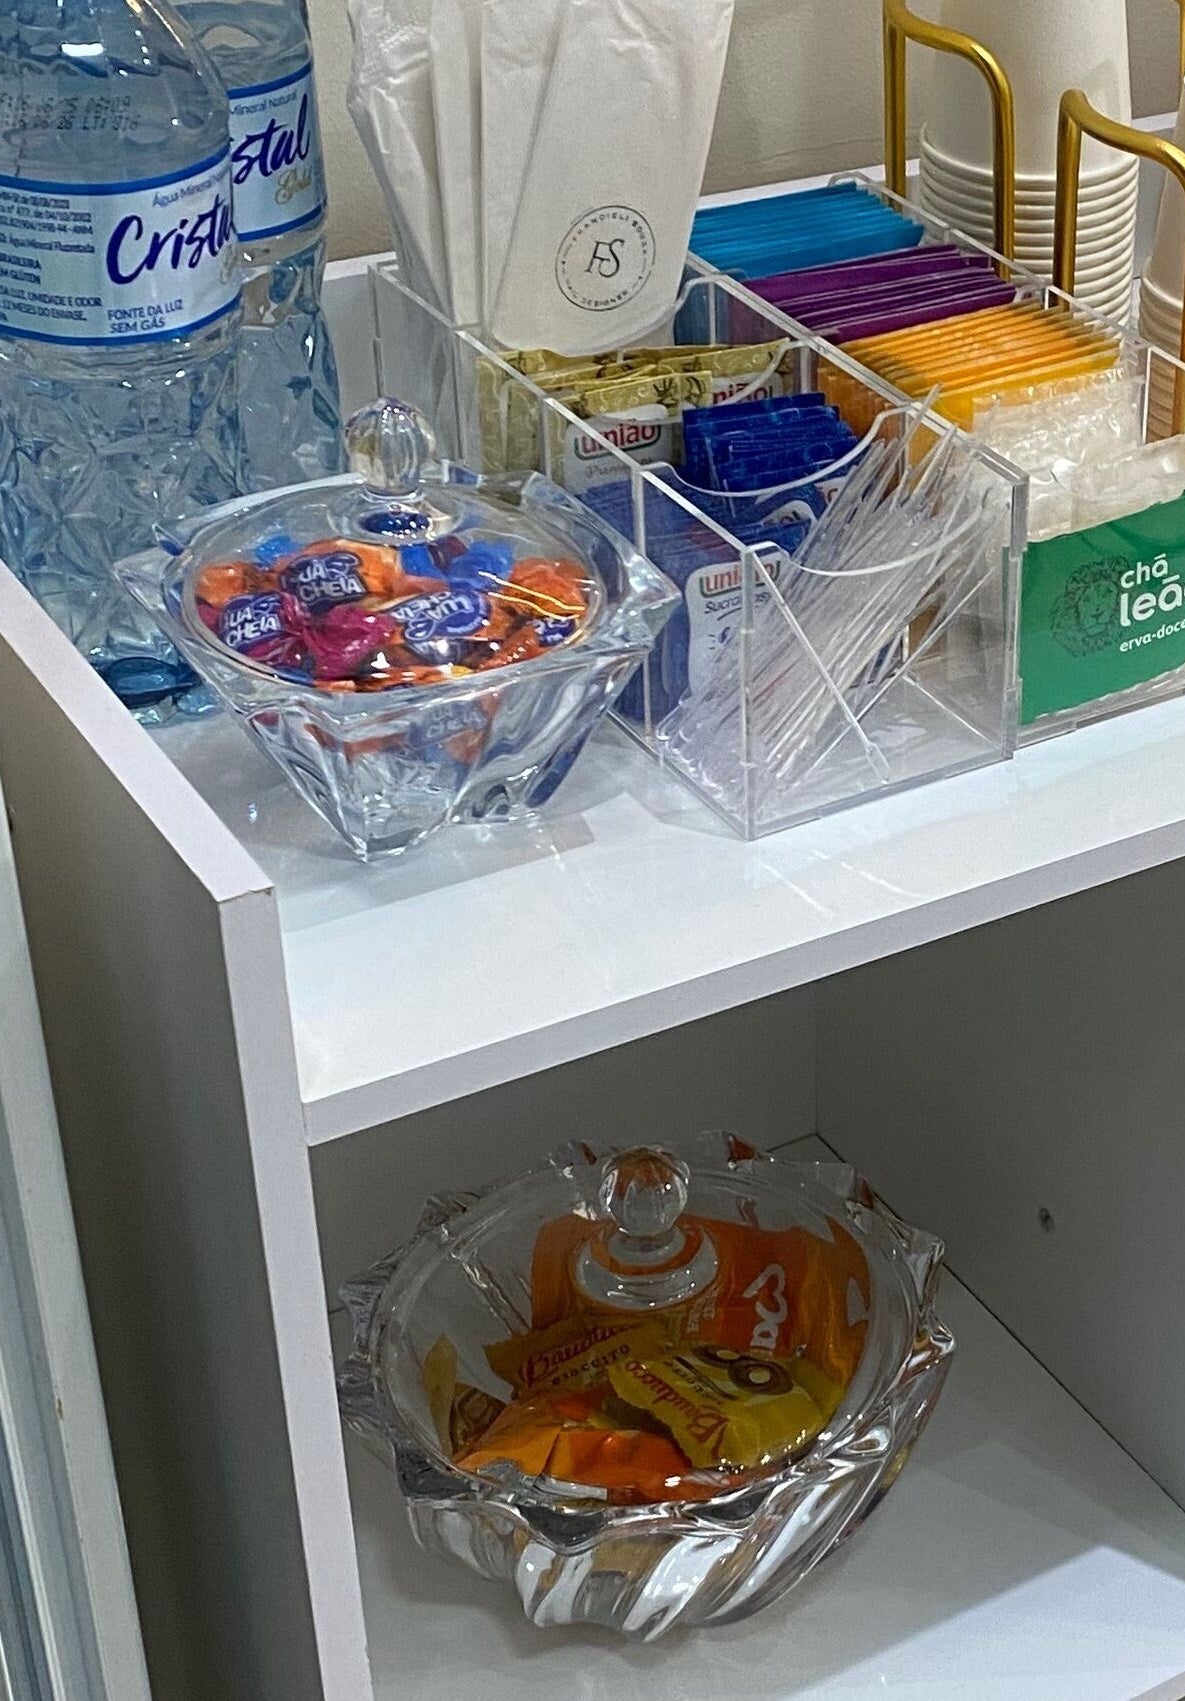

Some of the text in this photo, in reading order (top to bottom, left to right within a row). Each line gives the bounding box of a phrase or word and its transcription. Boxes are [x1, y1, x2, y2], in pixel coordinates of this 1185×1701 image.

[107, 299, 184, 321] FONTE DA LUZ
[110, 314, 166, 333] SEM GÁS
[300, 574, 365, 601] CHEIA
[225, 614, 282, 648] CHEIA
